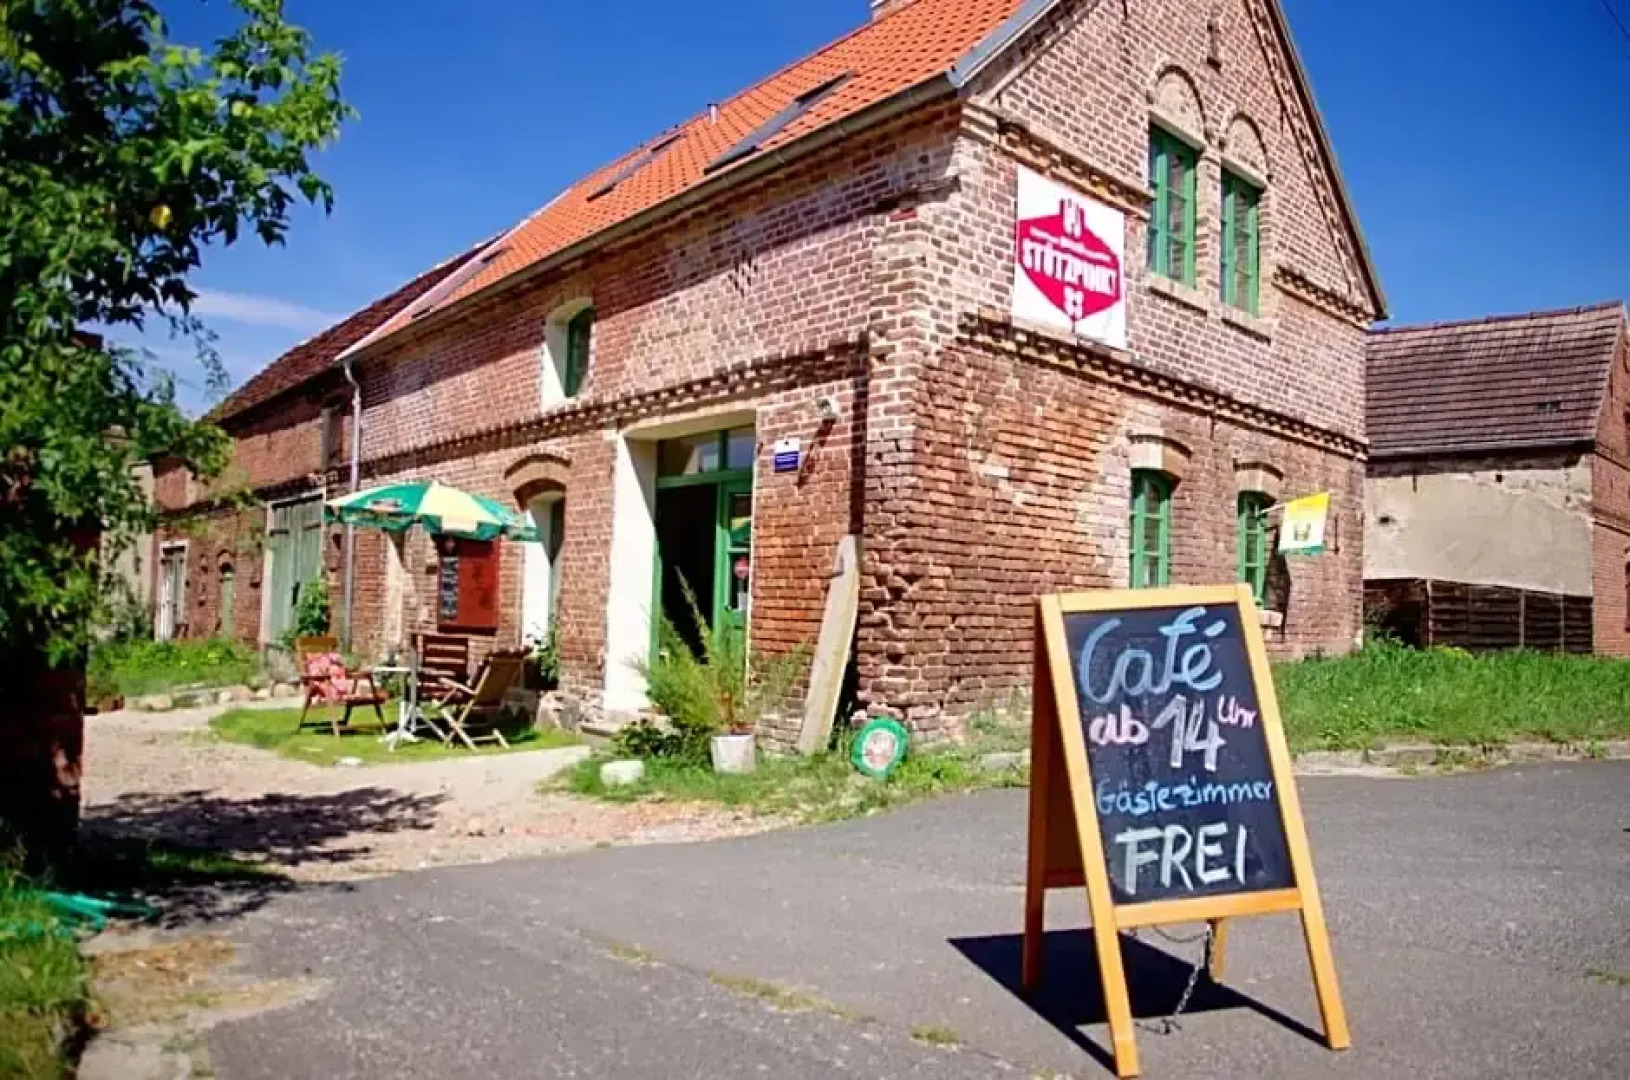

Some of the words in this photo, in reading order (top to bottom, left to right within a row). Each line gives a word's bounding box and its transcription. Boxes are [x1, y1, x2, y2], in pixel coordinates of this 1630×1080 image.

[1080, 606, 1226, 704] Café
[1089, 703, 1149, 746] ab
[1150, 694, 1227, 771] 14
[1217, 696, 1257, 728] Uhr
[1096, 775, 1273, 816] Gästezimmer
[1114, 822, 1248, 895] FREI
